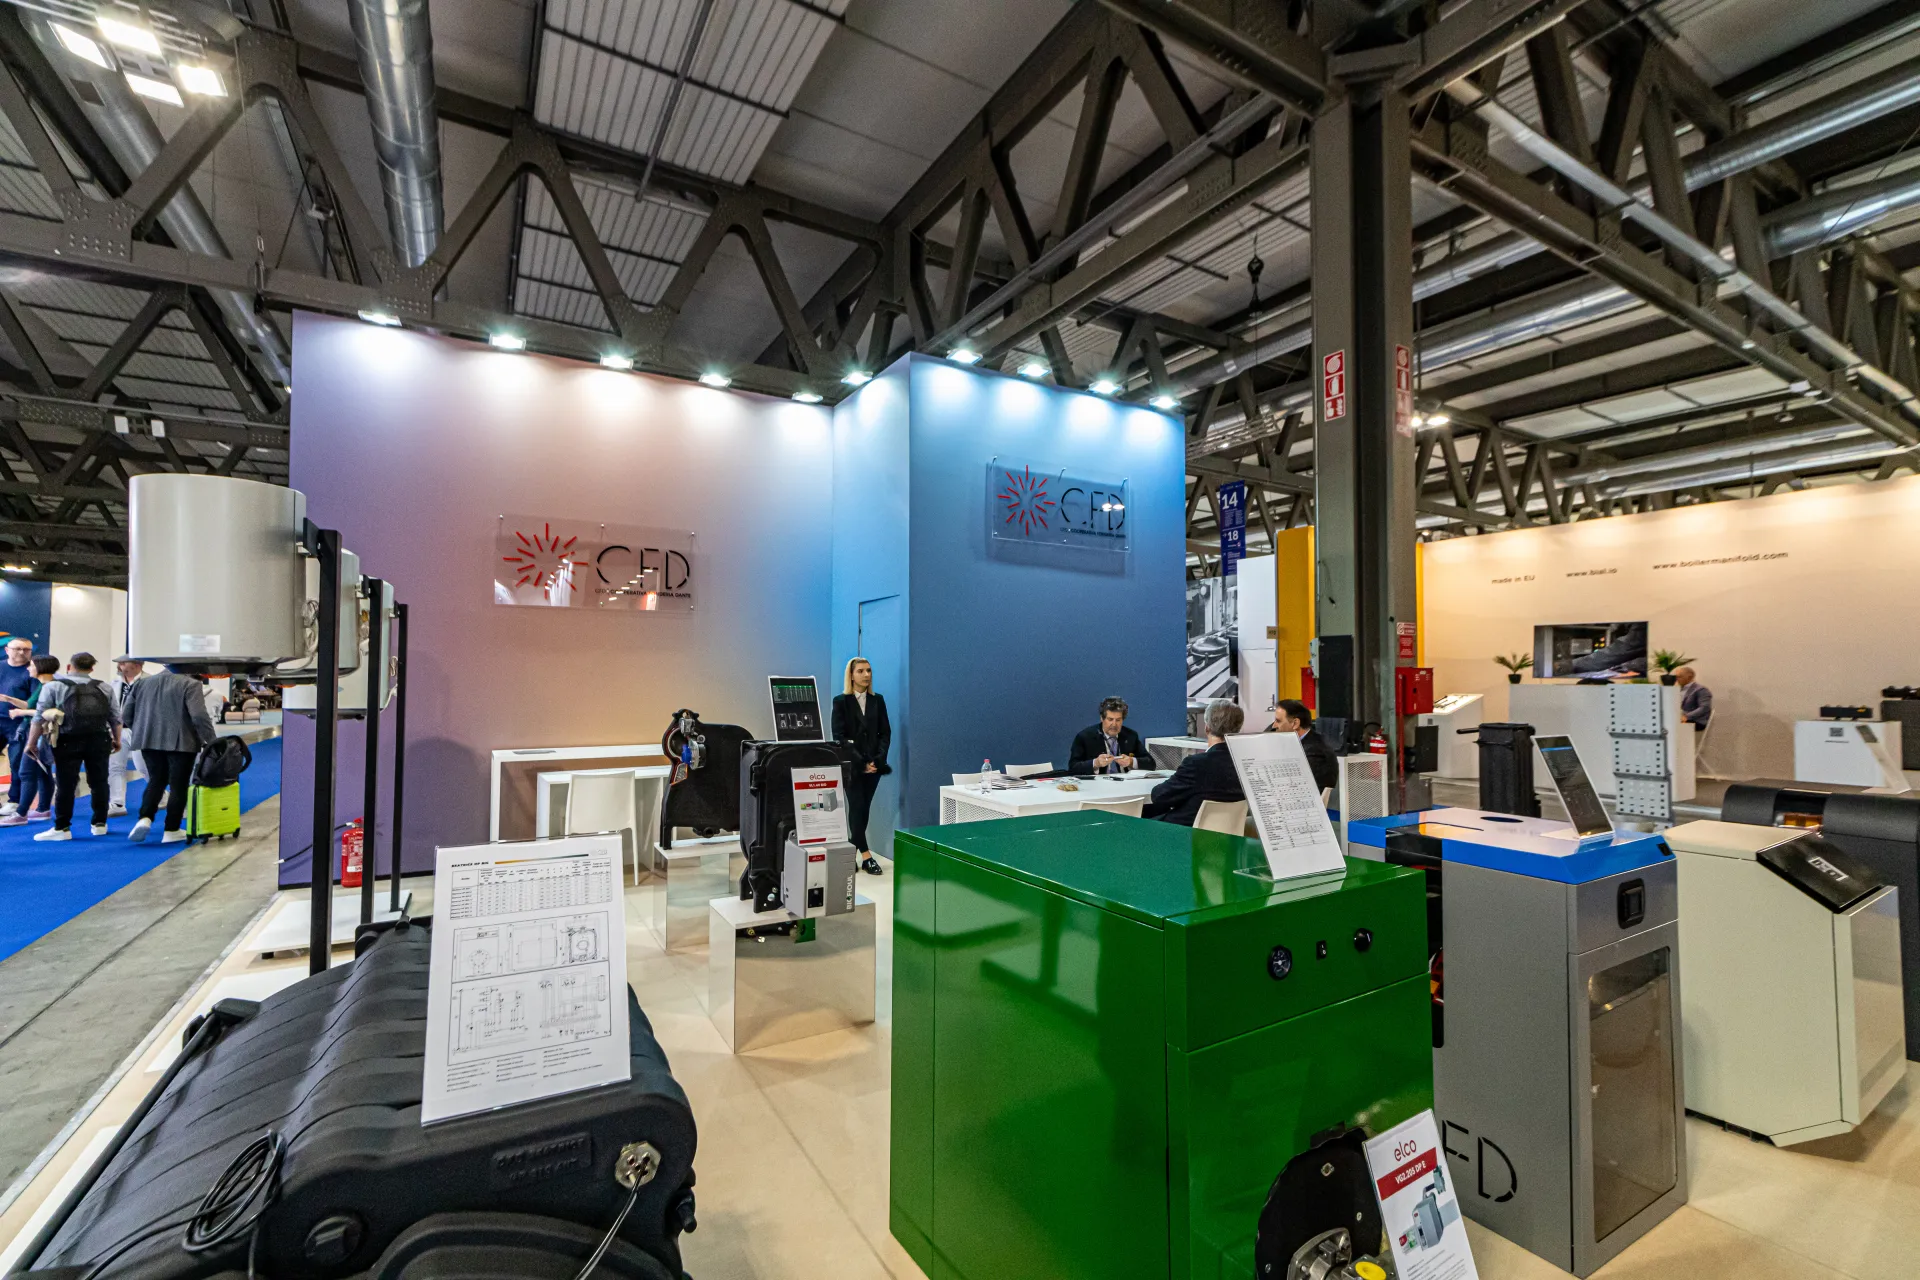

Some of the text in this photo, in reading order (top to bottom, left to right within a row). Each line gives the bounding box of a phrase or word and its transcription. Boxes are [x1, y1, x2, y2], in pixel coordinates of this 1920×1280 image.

[1060, 487, 1126, 530] CFD
[1221, 491, 1239, 510] 14
[1227, 530, 1239, 542] 18
[596, 545, 690, 589] CFD
[1491, 576, 1512, 585] made
[1524, 574, 1536, 583] EU
[809, 772, 826, 781] elco
[1394, 1139, 1417, 1162] elco
[1395, 1166, 1415, 1185] VG2.205
[1415, 1163, 1423, 1174] DP
